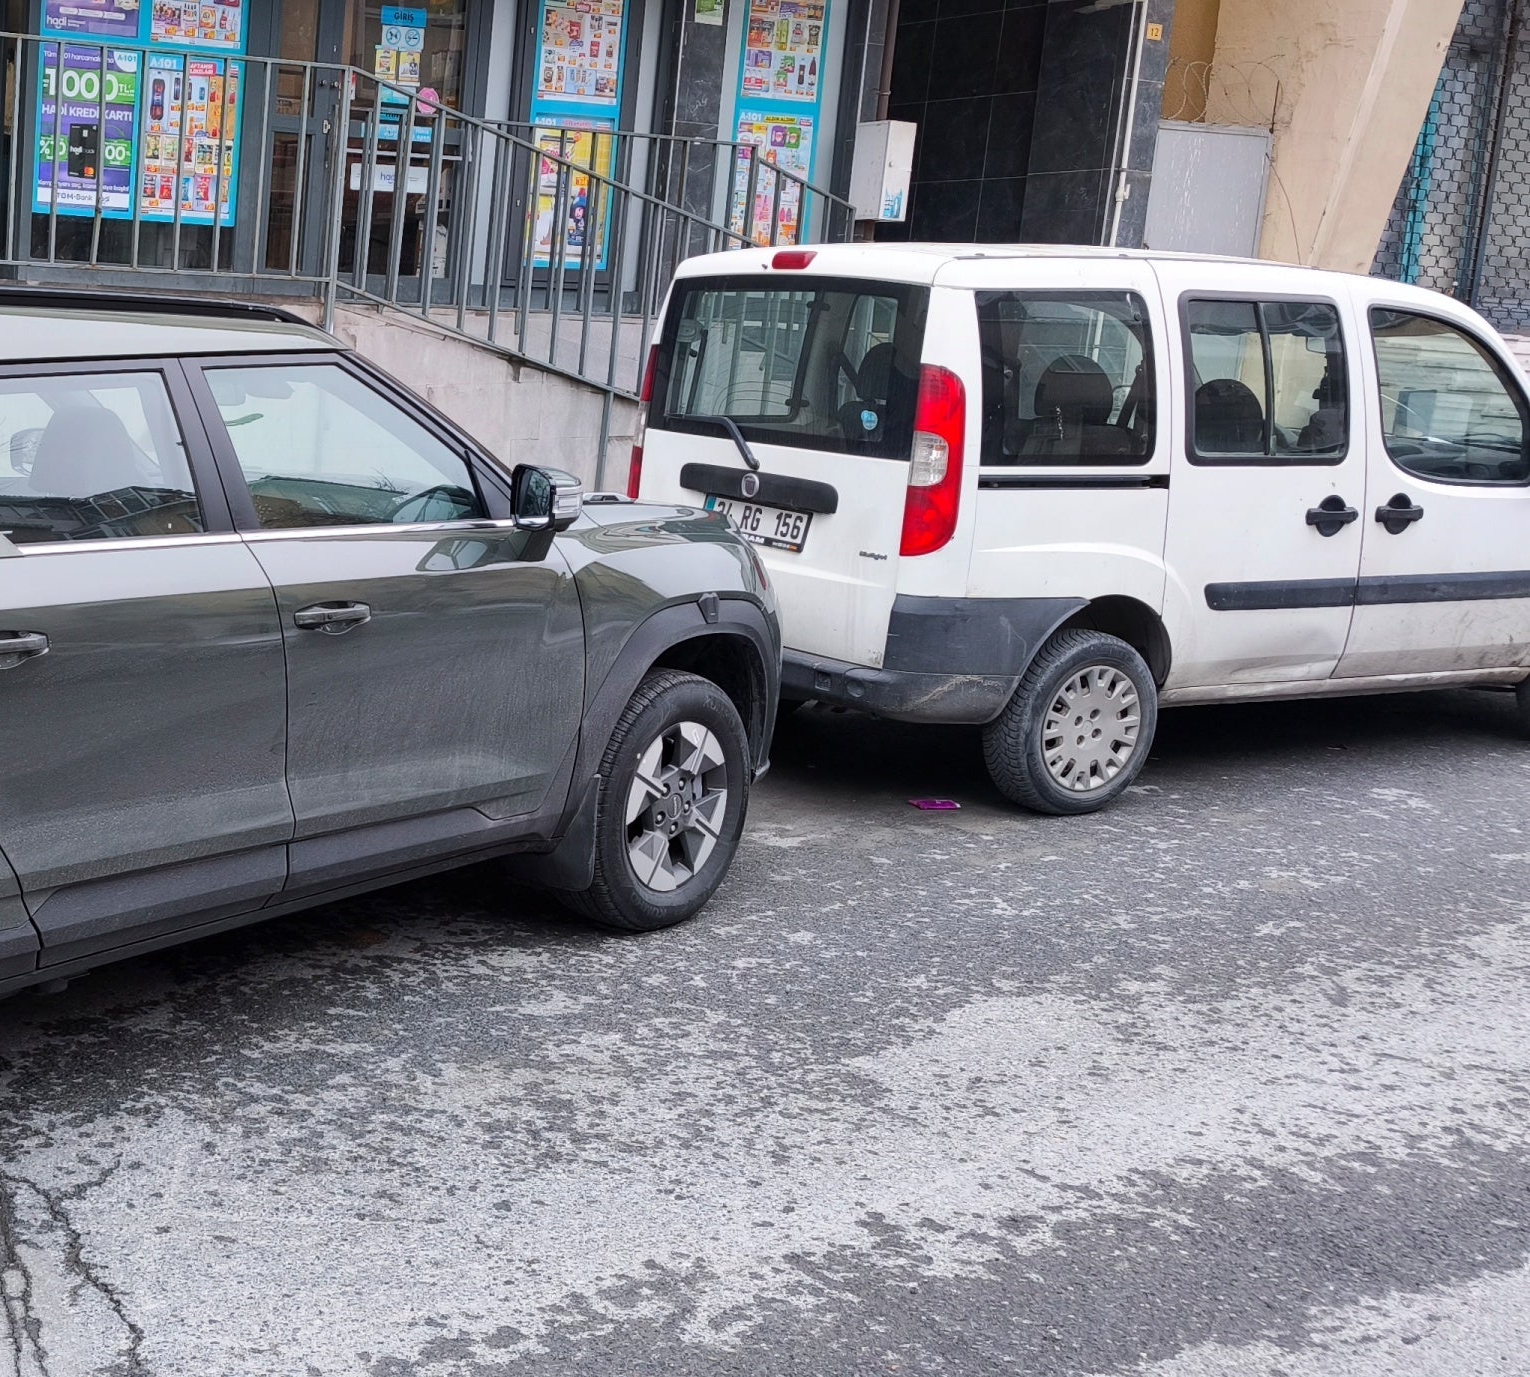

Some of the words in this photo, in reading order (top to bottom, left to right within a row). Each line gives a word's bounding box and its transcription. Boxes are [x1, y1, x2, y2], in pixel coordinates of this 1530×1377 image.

[46, 15, 67, 29] hadi
[393, 11, 415, 23] GİRİŞ
[69, 106, 100, 119] KREDİ
[740, 505, 763, 531] RG
[774, 511, 804, 540] 156
